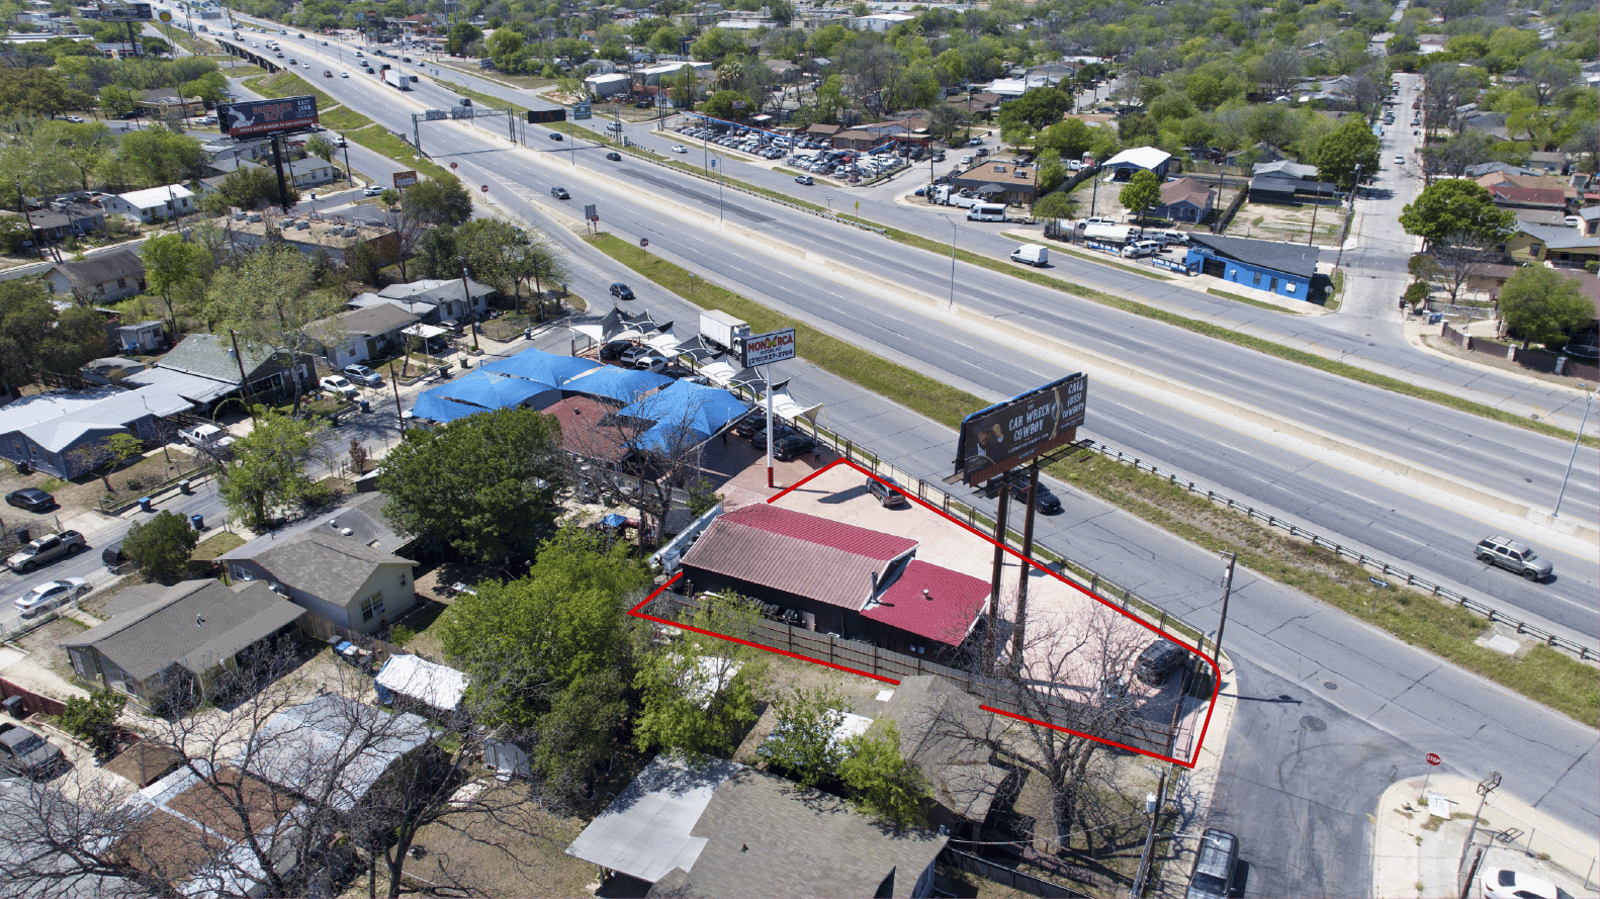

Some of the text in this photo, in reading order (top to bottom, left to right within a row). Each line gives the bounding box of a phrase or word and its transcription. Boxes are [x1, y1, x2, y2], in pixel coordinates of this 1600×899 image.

[252, 102, 293, 114] BURGER
[264, 111, 284, 121] BOY
[1067, 379, 1084, 395] CALL
[1008, 414, 1024, 432] CAR
[1026, 402, 1052, 424] WRECK
[1013, 419, 1044, 442] COWBOY
[1425, 754, 1441, 763] STOP
